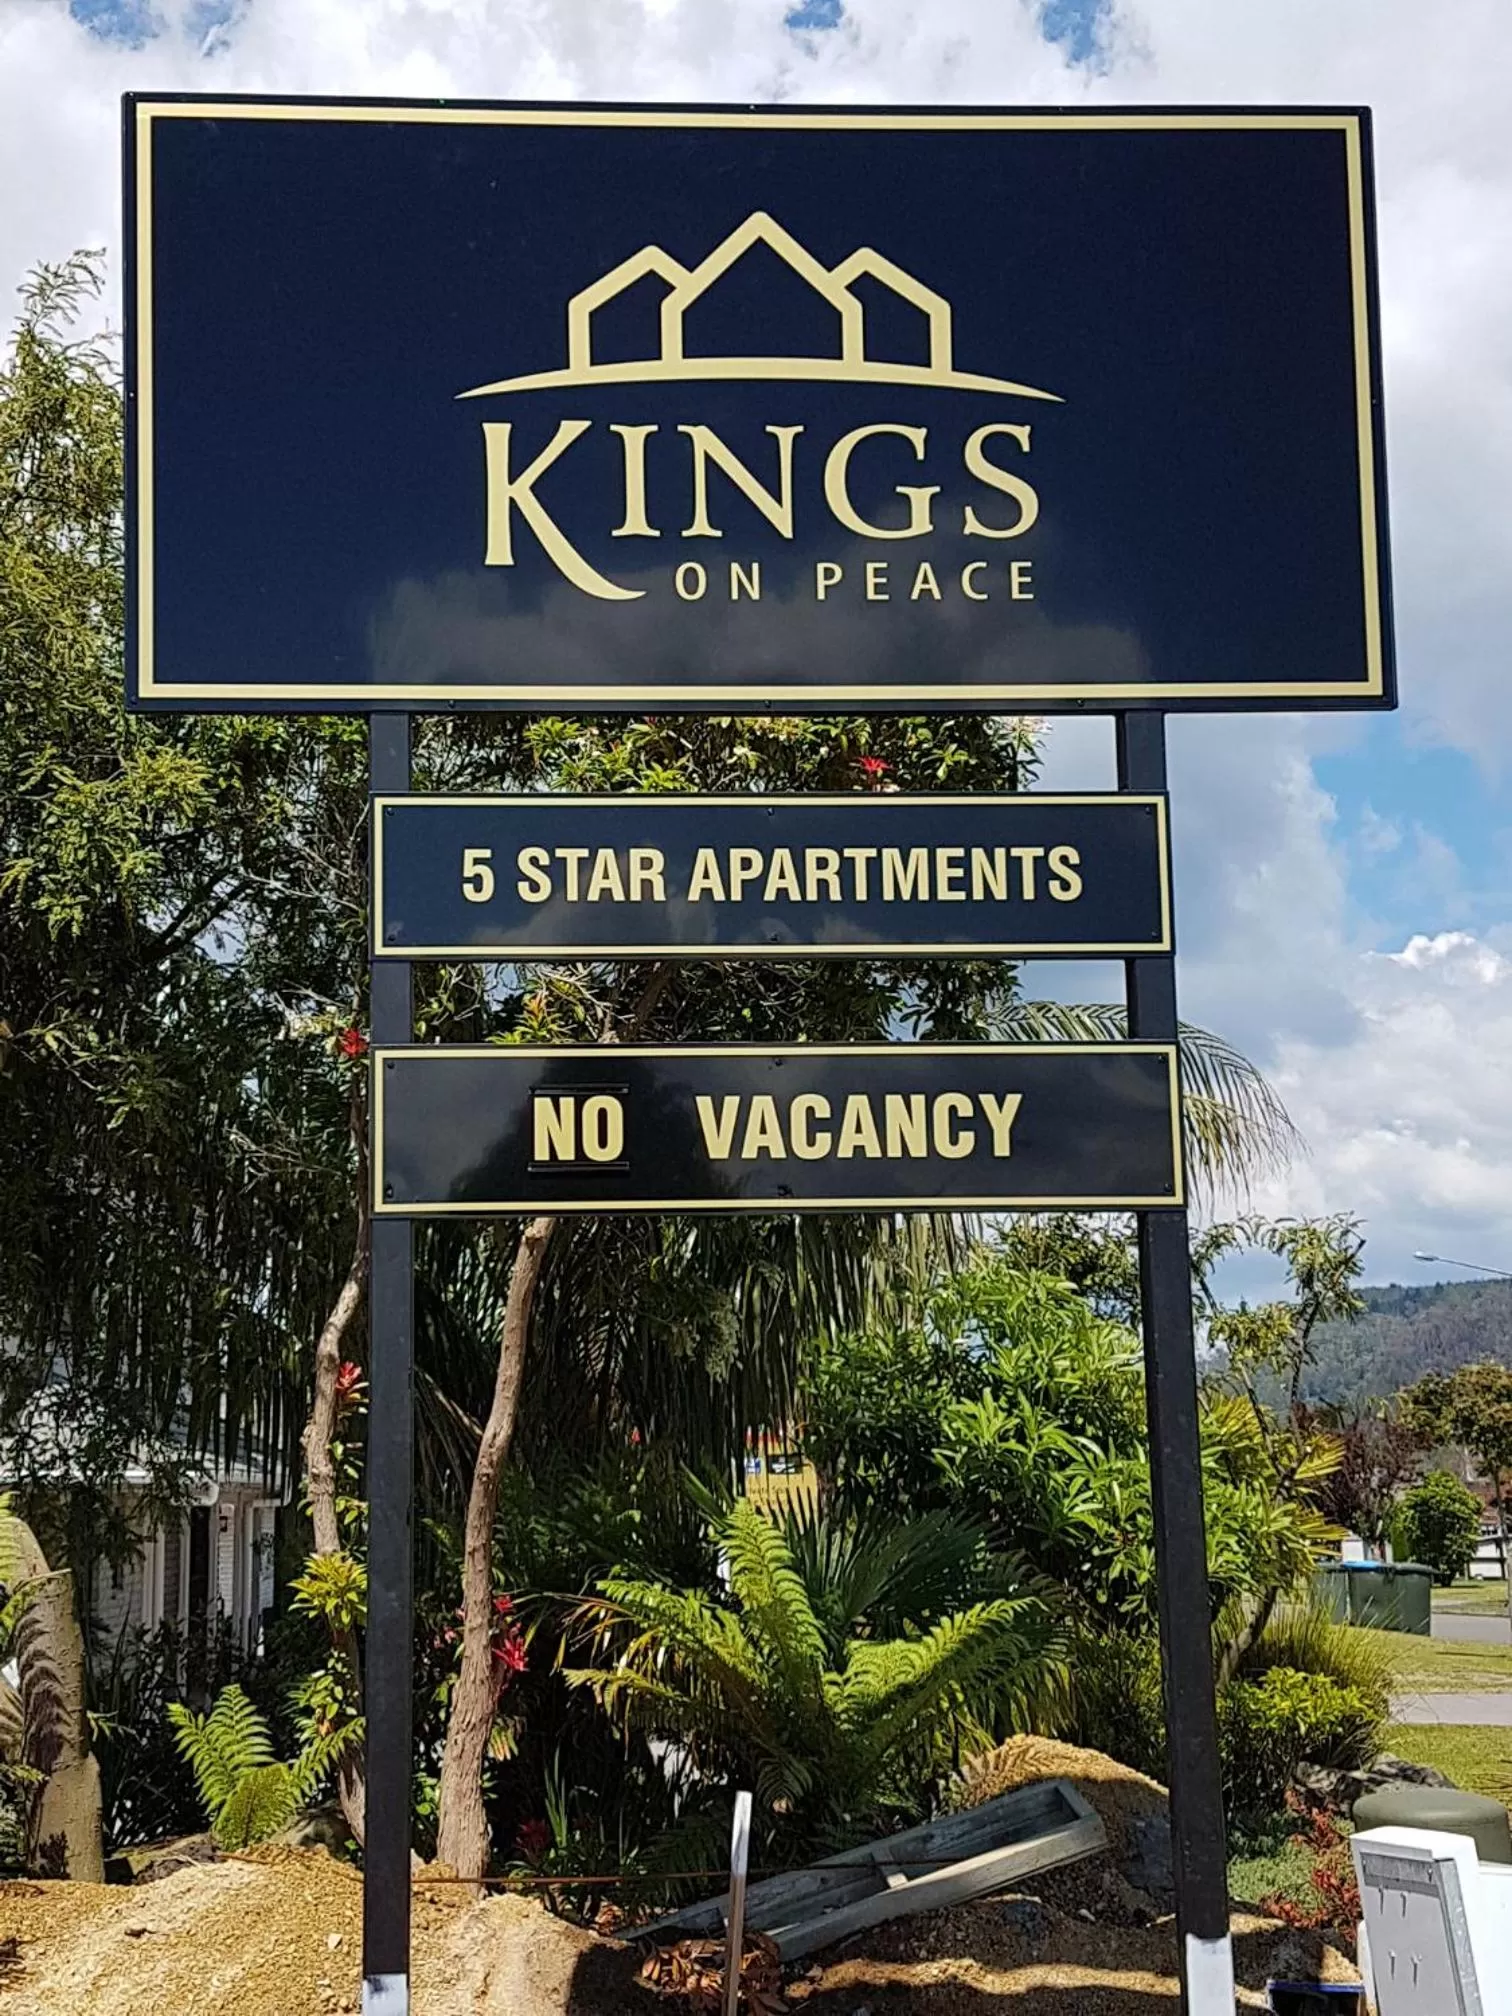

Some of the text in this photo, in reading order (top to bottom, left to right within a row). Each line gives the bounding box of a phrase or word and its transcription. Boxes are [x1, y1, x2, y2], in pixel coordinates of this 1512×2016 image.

[482, 420, 1040, 601] KINGS
[675, 561, 1034, 601] ON PEACE
[462, 846, 1083, 903] 5 STAR APARTMENTS
[533, 1092, 1023, 1162] NO VACANCY
